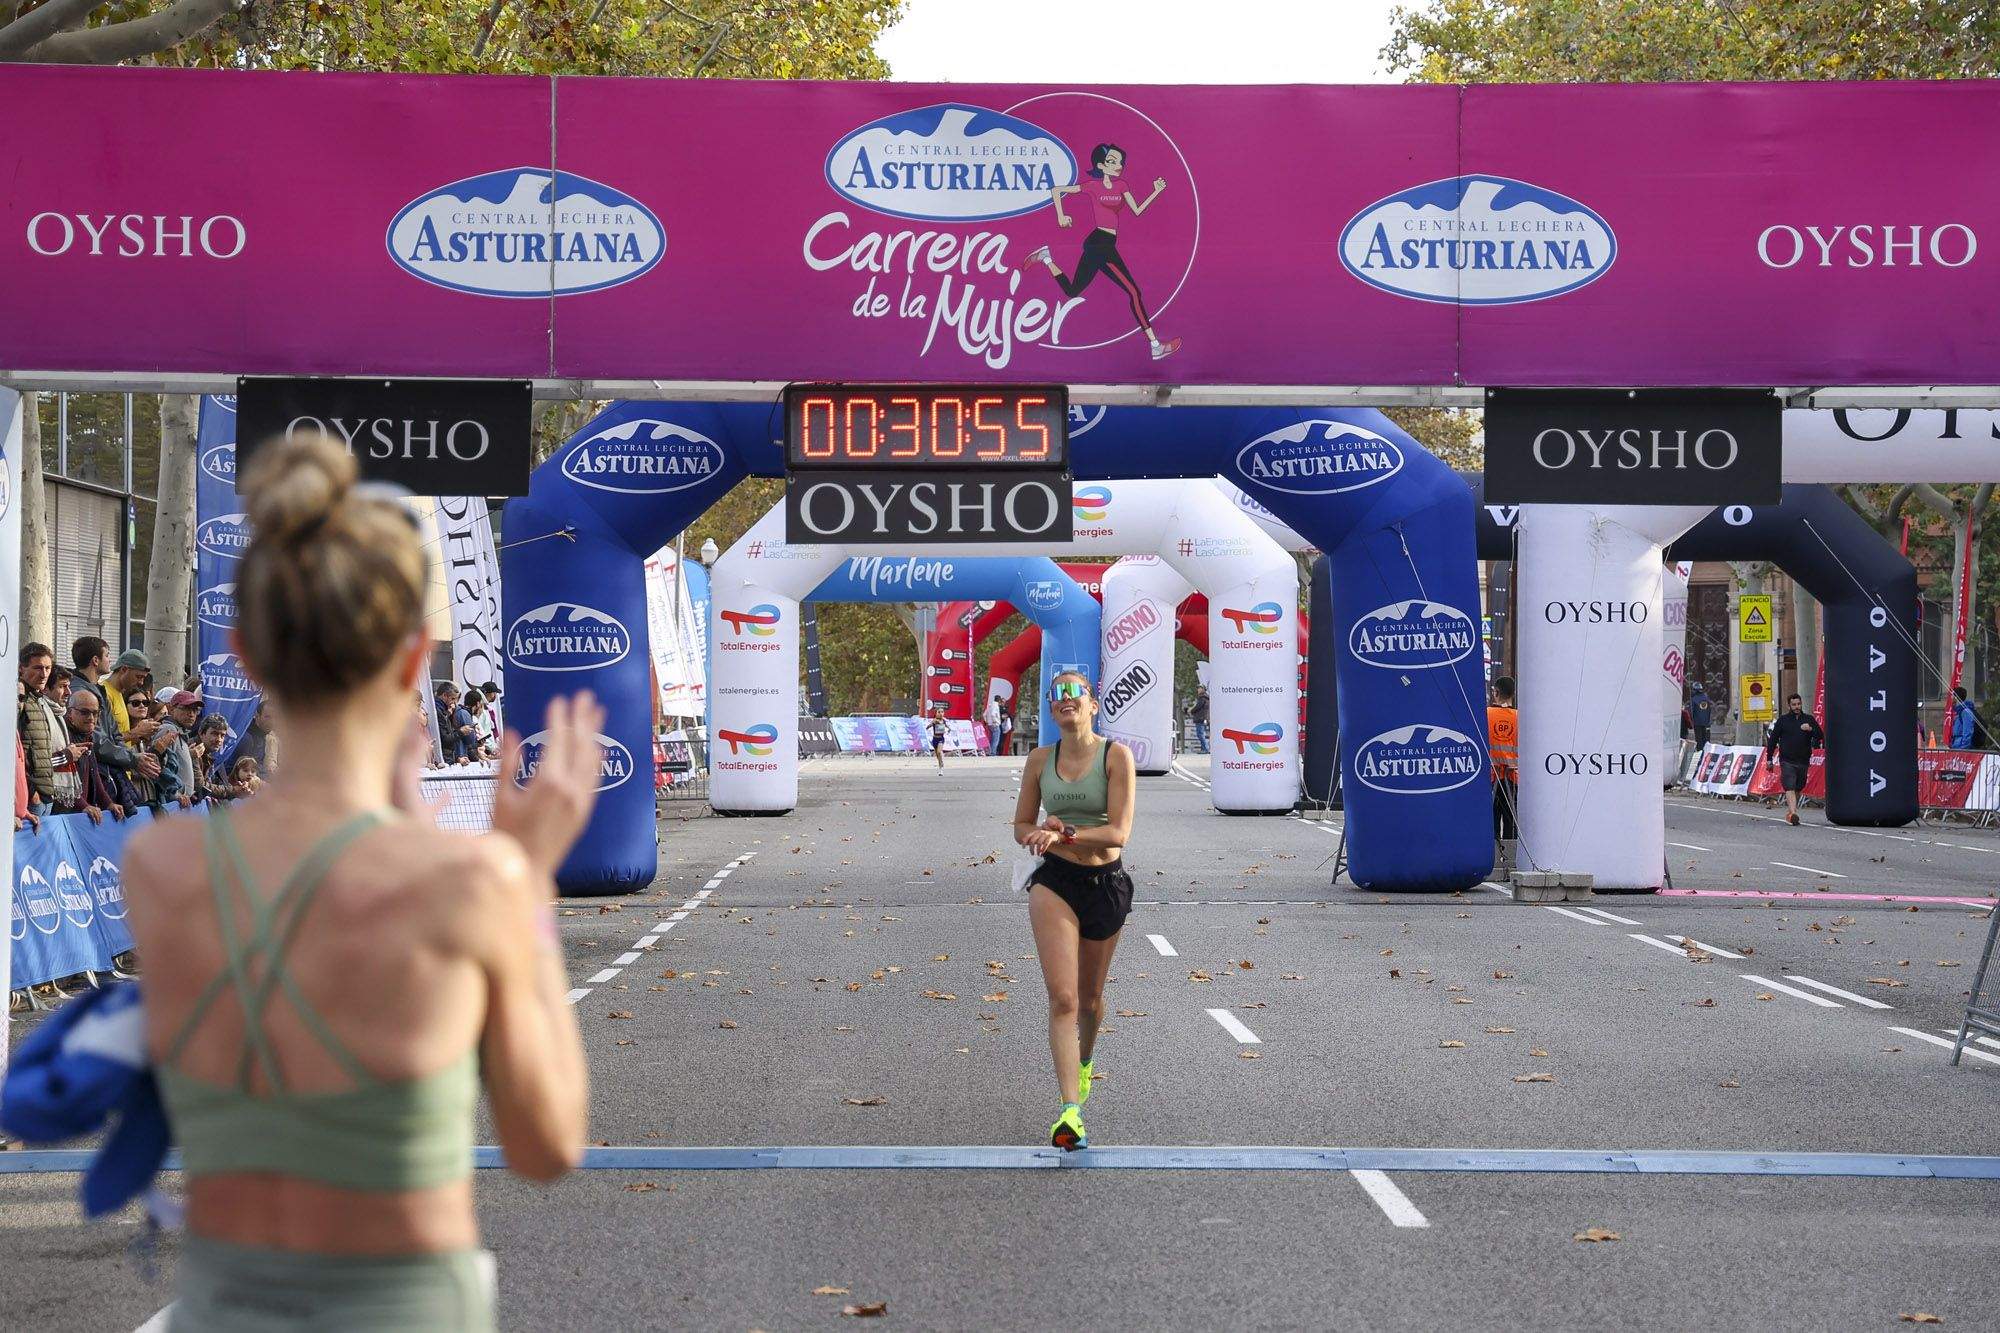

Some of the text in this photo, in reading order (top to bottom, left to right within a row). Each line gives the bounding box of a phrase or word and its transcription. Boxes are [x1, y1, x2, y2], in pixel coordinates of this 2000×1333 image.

[884, 144, 1050, 157] CENTRAL LECHERA
[845, 146, 1056, 192] ASTURIANA
[452, 212, 635, 225] CENTRAL LECHERA
[1404, 219, 1586, 232] CENTRAL LECHERA
[26, 211, 247, 259] OYSHO
[408, 214, 644, 263] ASTURIANA
[802, 211, 1011, 274] Carrera
[1361, 222, 1594, 270] ASTURIANA
[1757, 223, 1978, 268] OYSHO
[852, 271, 1086, 369] de la Mujer
[803, 398, 1049, 458] 00:30:55
[598, 444, 708, 453] CENTRAL LECHERA
[1271, 442, 1384, 456] CENTRAL LECHERA
[1532, 428, 1739, 470] OYSHO
[571, 449, 711, 474] ASTURIANA
[1251, 451, 1394, 478] ASTURIANA
[800, 481, 1059, 535] OYSHO
[1072, 526, 1114, 539] nergies
[848, 556, 955, 596] Marlene
[1544, 601, 1648, 624] OYSHO
[525, 625, 618, 635] CENTRAL LECHERA
[1106, 604, 1156, 652] COSMO
[1375, 621, 1466, 632] CENTRAL LECHERA
[511, 631, 622, 657] ASTURIANA
[720, 642, 781, 652] TotalEnergies
[1221, 640, 1284, 651] TotalEnergies
[1357, 628, 1470, 653] ASTURIANA
[719, 687, 780, 695] totalenergies.es
[1104, 665, 1151, 717] COSMO
[1221, 686, 1284, 694] totalenergies.es
[1380, 746, 1472, 757] CENTRAL LECHERA
[717, 761, 778, 772] TotalEnergies
[1222, 761, 1284, 771] TotalEnergies
[1362, 751, 1476, 778] ASTURIANA
[1544, 752, 1648, 776] OYSHO
[1053, 793, 1086, 801] OYSHO
